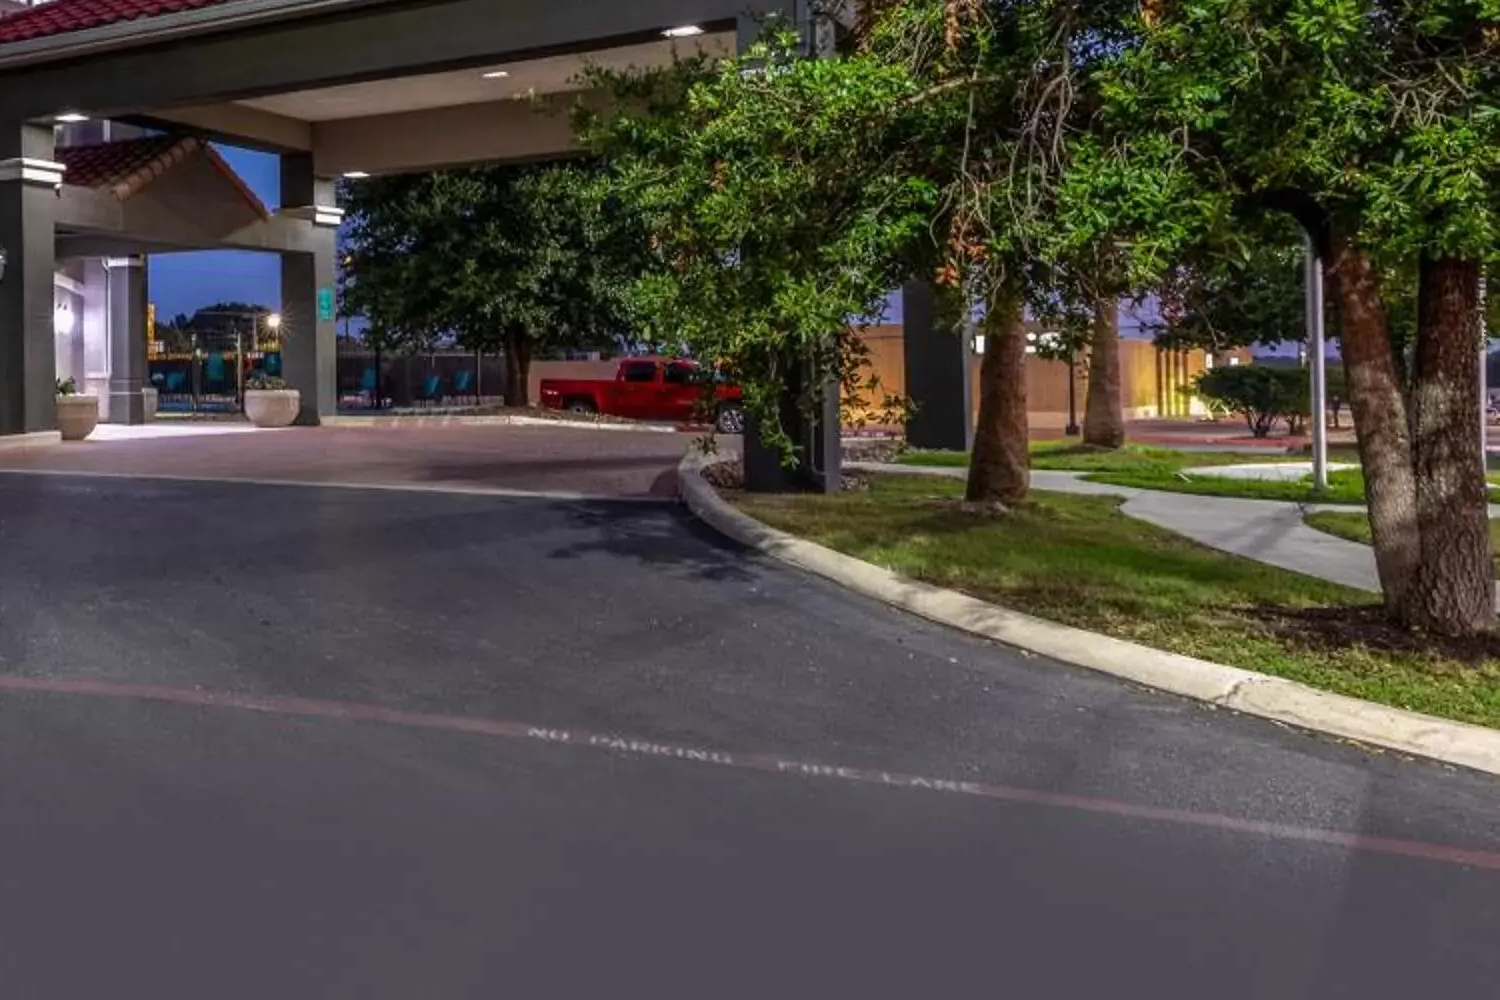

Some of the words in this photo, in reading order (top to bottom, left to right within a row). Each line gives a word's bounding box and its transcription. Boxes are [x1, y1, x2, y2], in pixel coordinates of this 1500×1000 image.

[527, 727, 570, 742] NO
[590, 734, 733, 764] PARKING
[881, 771, 982, 795] LANE
